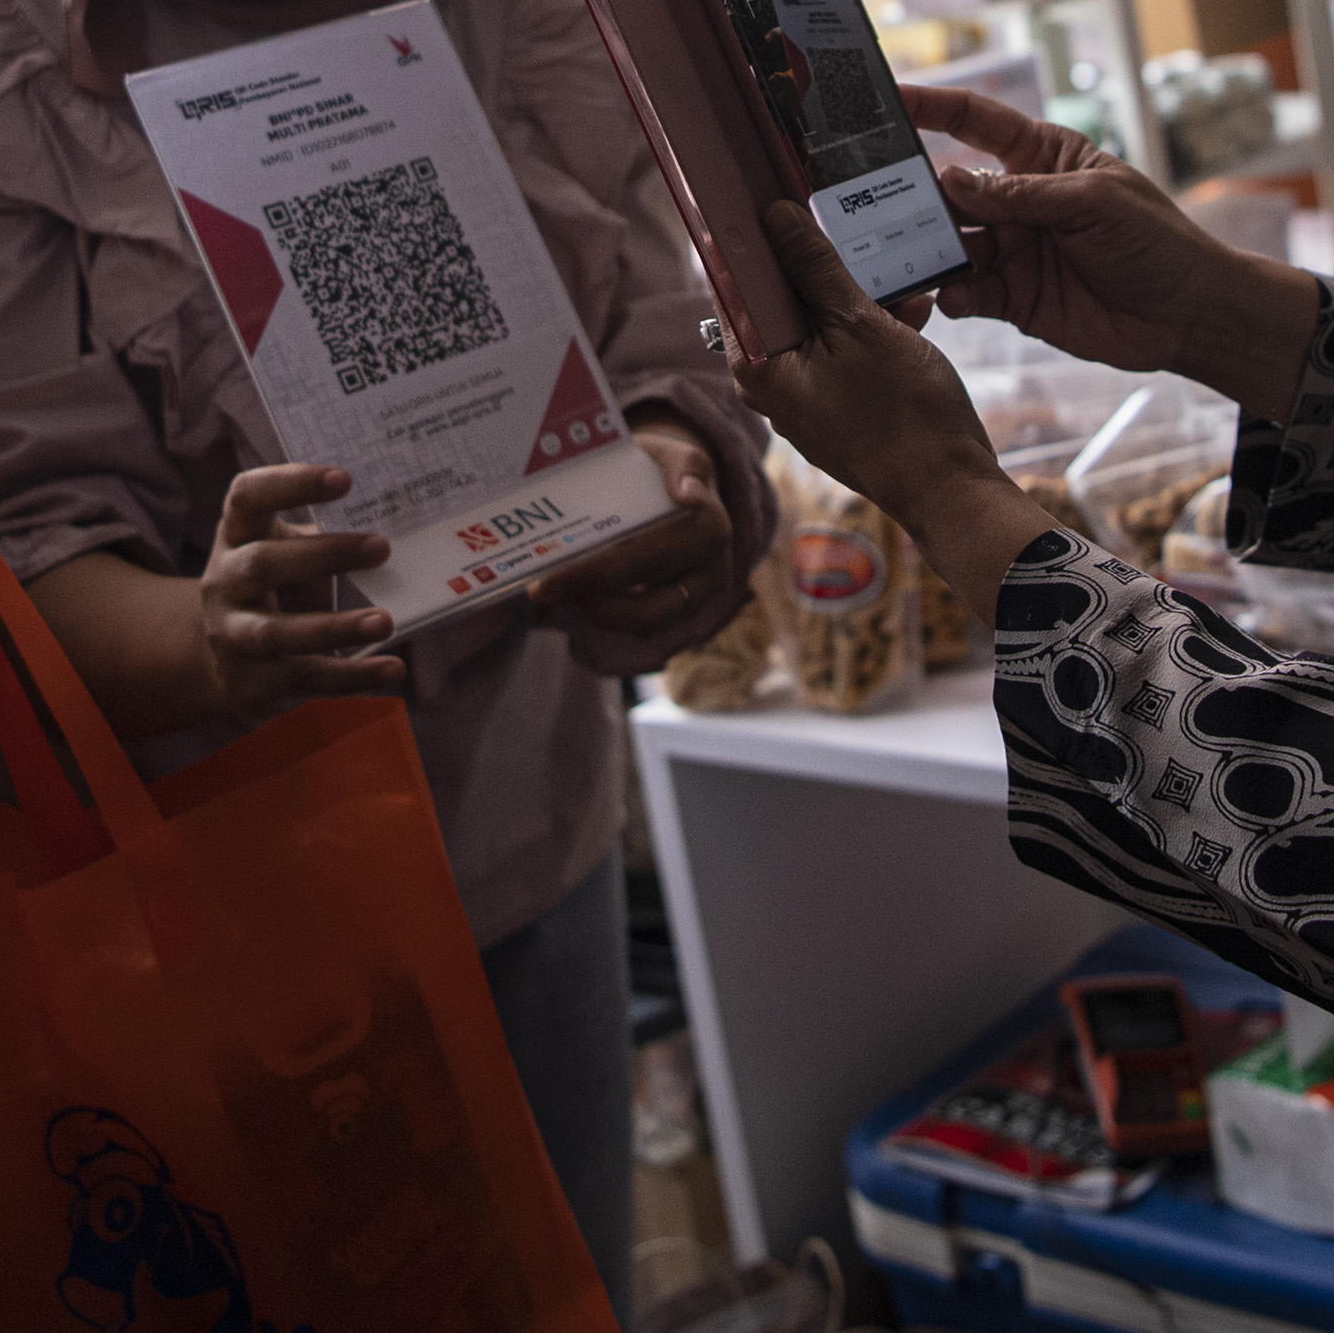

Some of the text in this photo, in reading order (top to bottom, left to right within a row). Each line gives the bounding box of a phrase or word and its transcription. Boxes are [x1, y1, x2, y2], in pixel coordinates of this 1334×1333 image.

[179, 90, 237, 122] QRIS
[315, 93, 354, 111] SINAR
[267, 106, 367, 141] MULTI PRATAMA
[840, 189, 874, 215] QRIS
[491, 497, 564, 539] BNI
